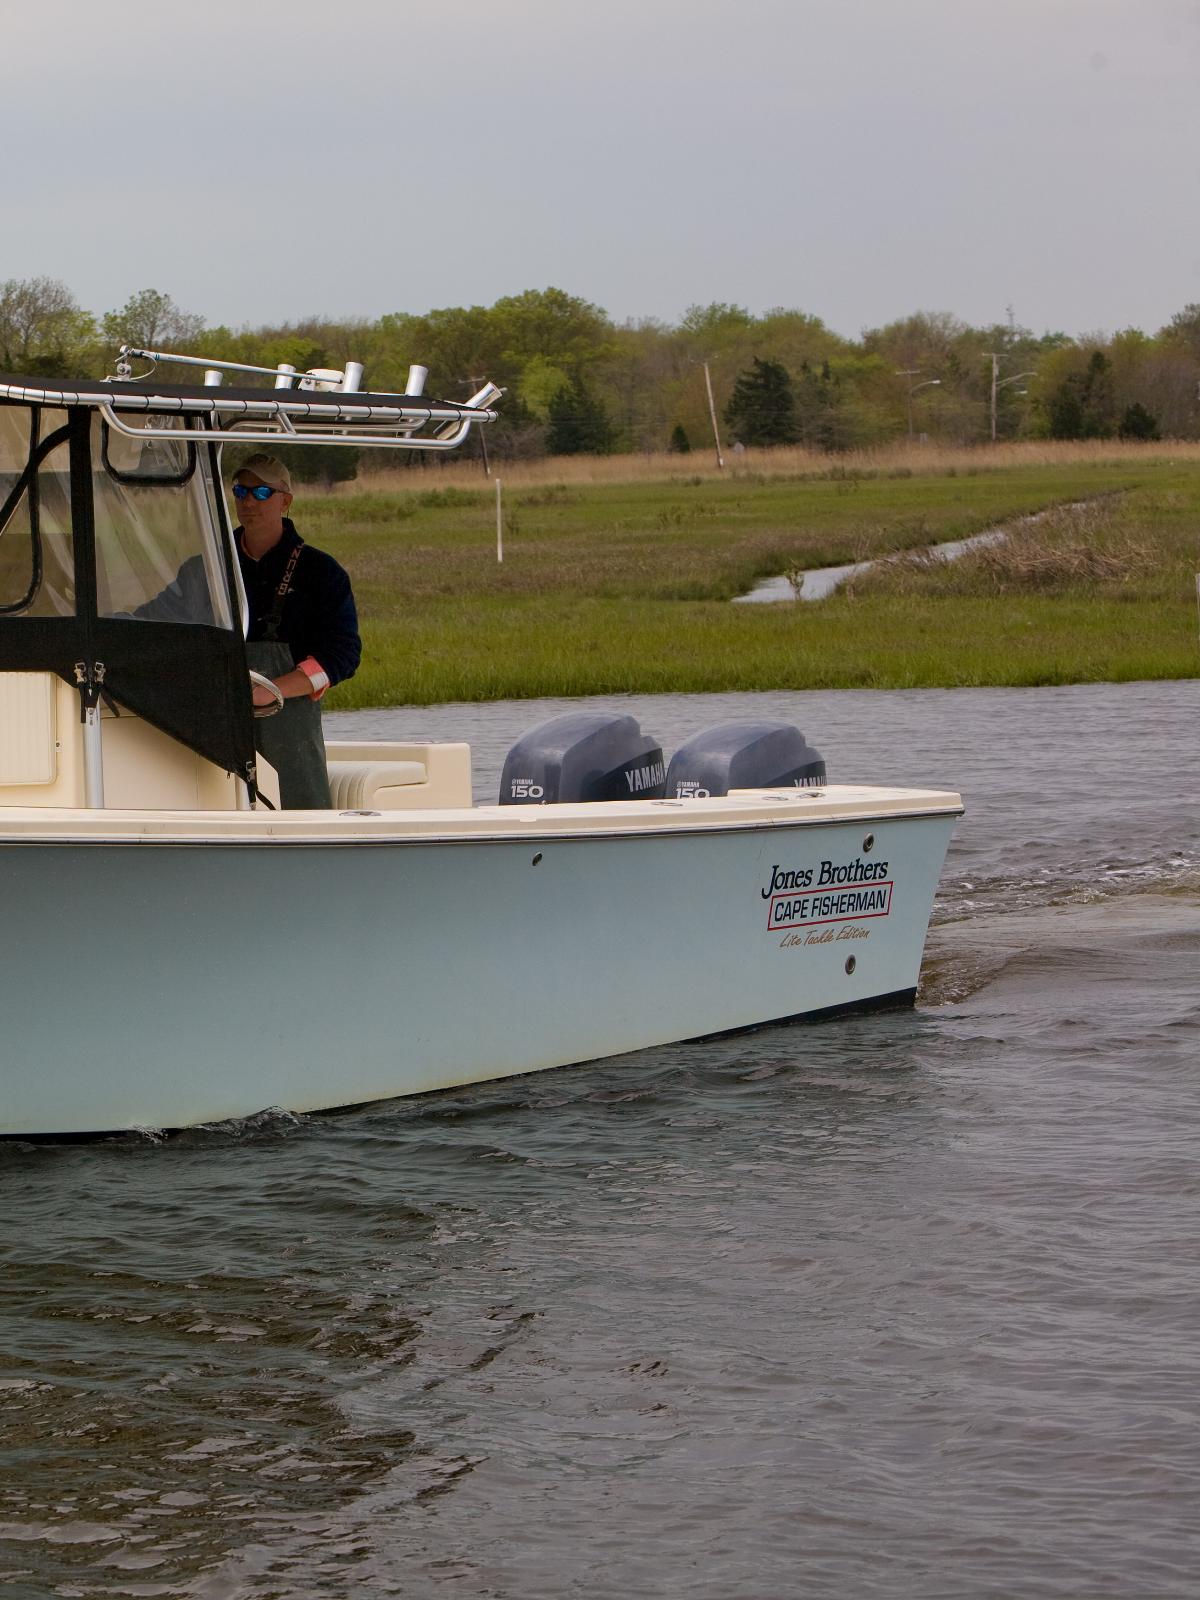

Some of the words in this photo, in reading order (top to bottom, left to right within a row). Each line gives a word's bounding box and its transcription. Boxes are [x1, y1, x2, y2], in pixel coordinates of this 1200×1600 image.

[278, 542, 305, 596] GRUN
[511, 785, 544, 798] 150
[624, 761, 665, 793] YAMAHA
[676, 787, 710, 799] 150
[761, 865, 813, 899] Jones
[817, 858, 889, 886] Brothers
[774, 898, 809, 922] CAPE
[811, 889, 887, 917] FISHERMAN
[779, 932, 802, 948] Lite
[803, 928, 834, 947] Tackle
[835, 925, 870, 941] Edition
